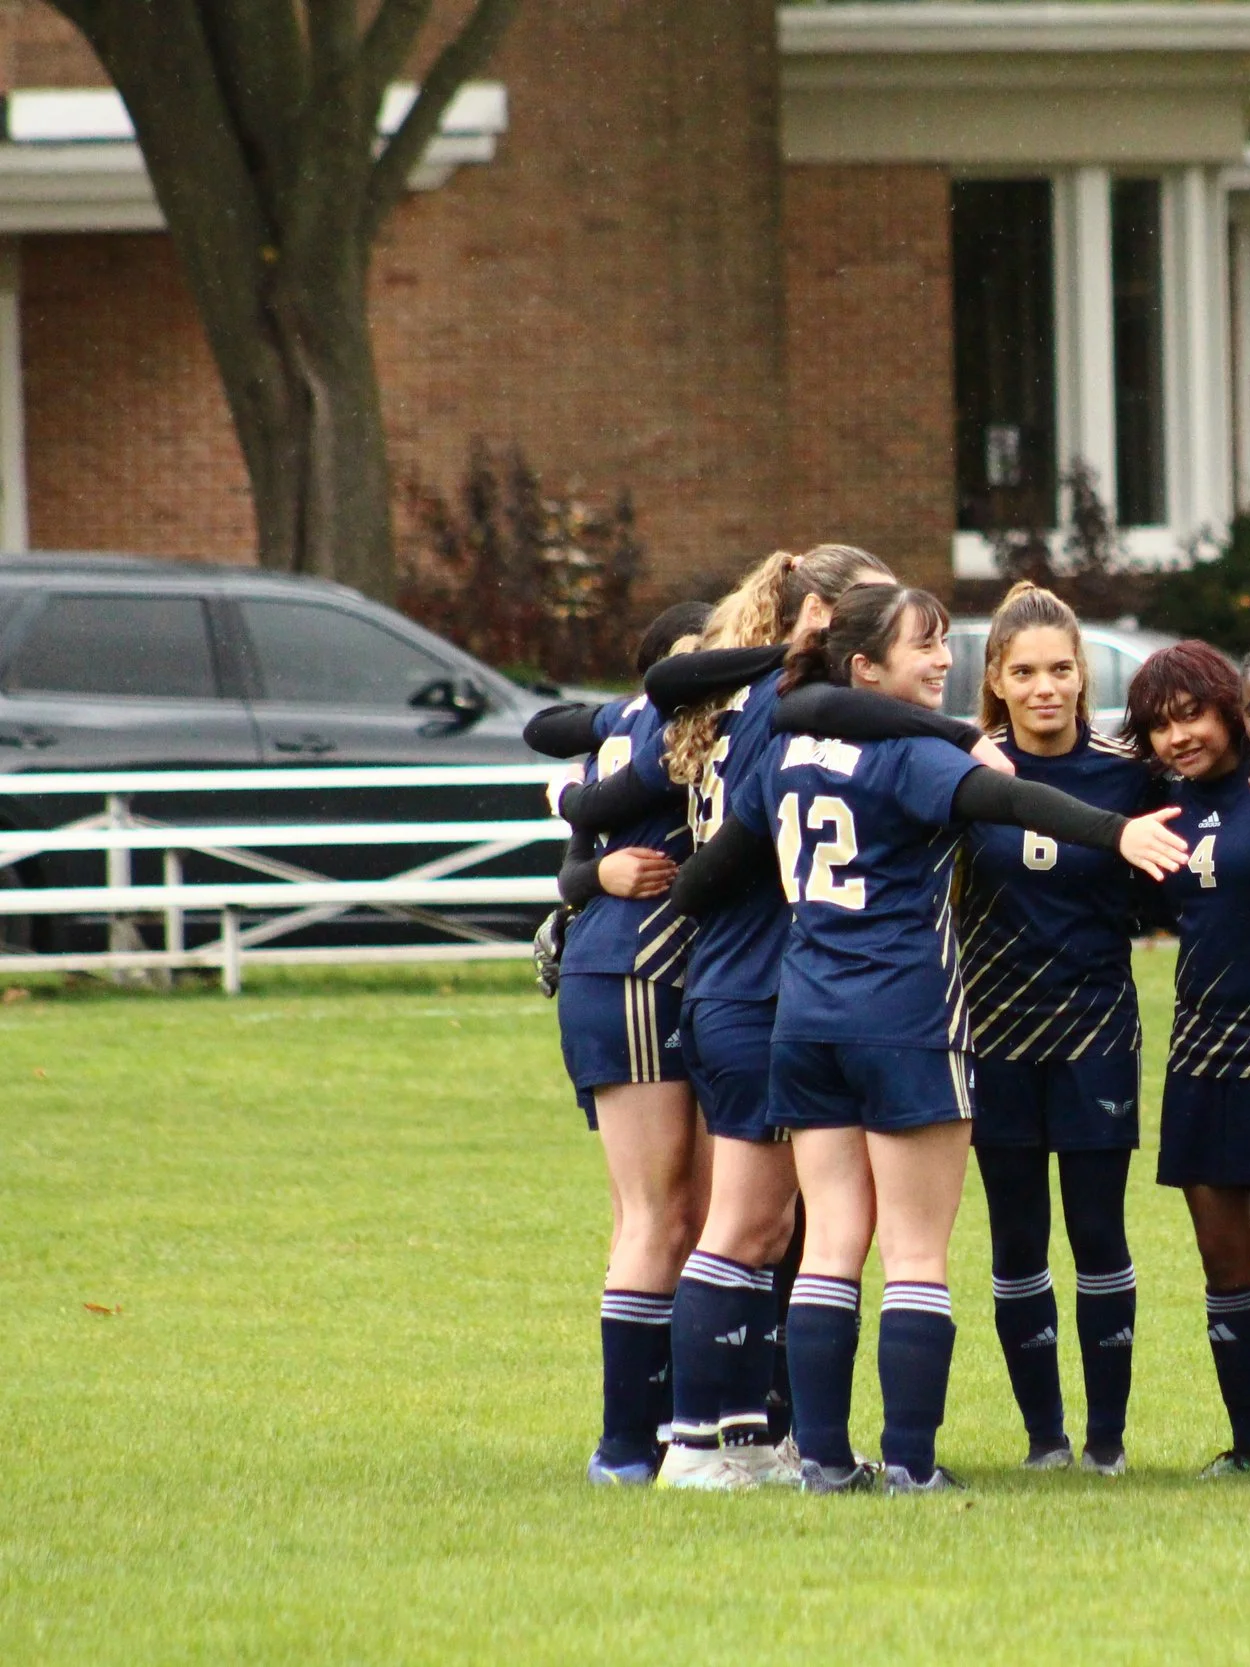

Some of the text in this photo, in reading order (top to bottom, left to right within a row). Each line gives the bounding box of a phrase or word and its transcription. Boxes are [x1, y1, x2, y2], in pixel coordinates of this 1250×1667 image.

[1198, 821, 1222, 829] adidas
[777, 792, 866, 910] 12
[1023, 829, 1058, 871] 6
[1187, 834, 1217, 888] 4
